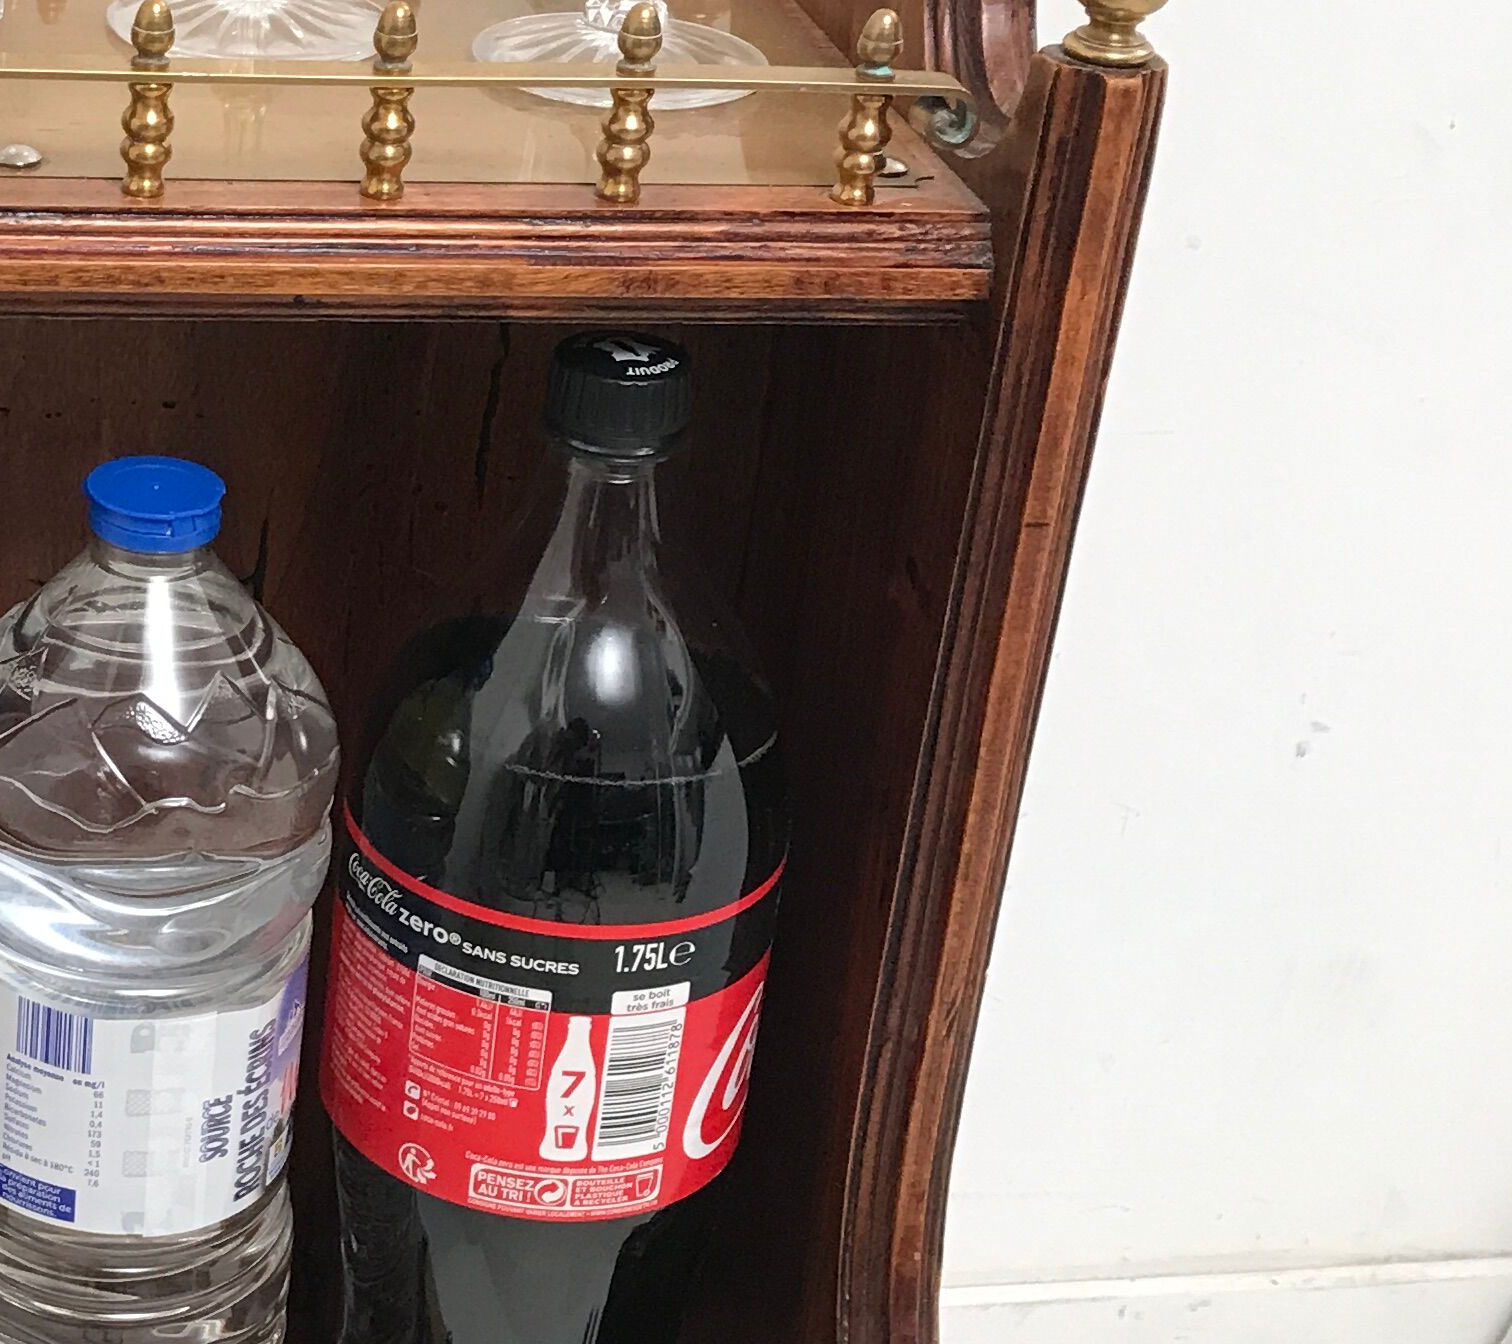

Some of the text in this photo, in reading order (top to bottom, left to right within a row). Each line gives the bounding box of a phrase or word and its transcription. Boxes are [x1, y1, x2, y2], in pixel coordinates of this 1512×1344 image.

[462, 942, 507, 964] SANS
[510, 955, 580, 976] SUCRES
[626, 997, 675, 1013] très frais
[632, 989, 671, 1003] se boit
[559, 1070, 587, 1100] 7
[240, 1088, 269, 1136] DES
[198, 1093, 233, 1163] SOURCE
[233, 1125, 266, 1202] ROCHE
[476, 1170, 535, 1190] PENSEZ
[477, 1183, 498, 1197] AU
[500, 1187, 524, 1202] TRI
[58, 1203, 72, 1214] de
